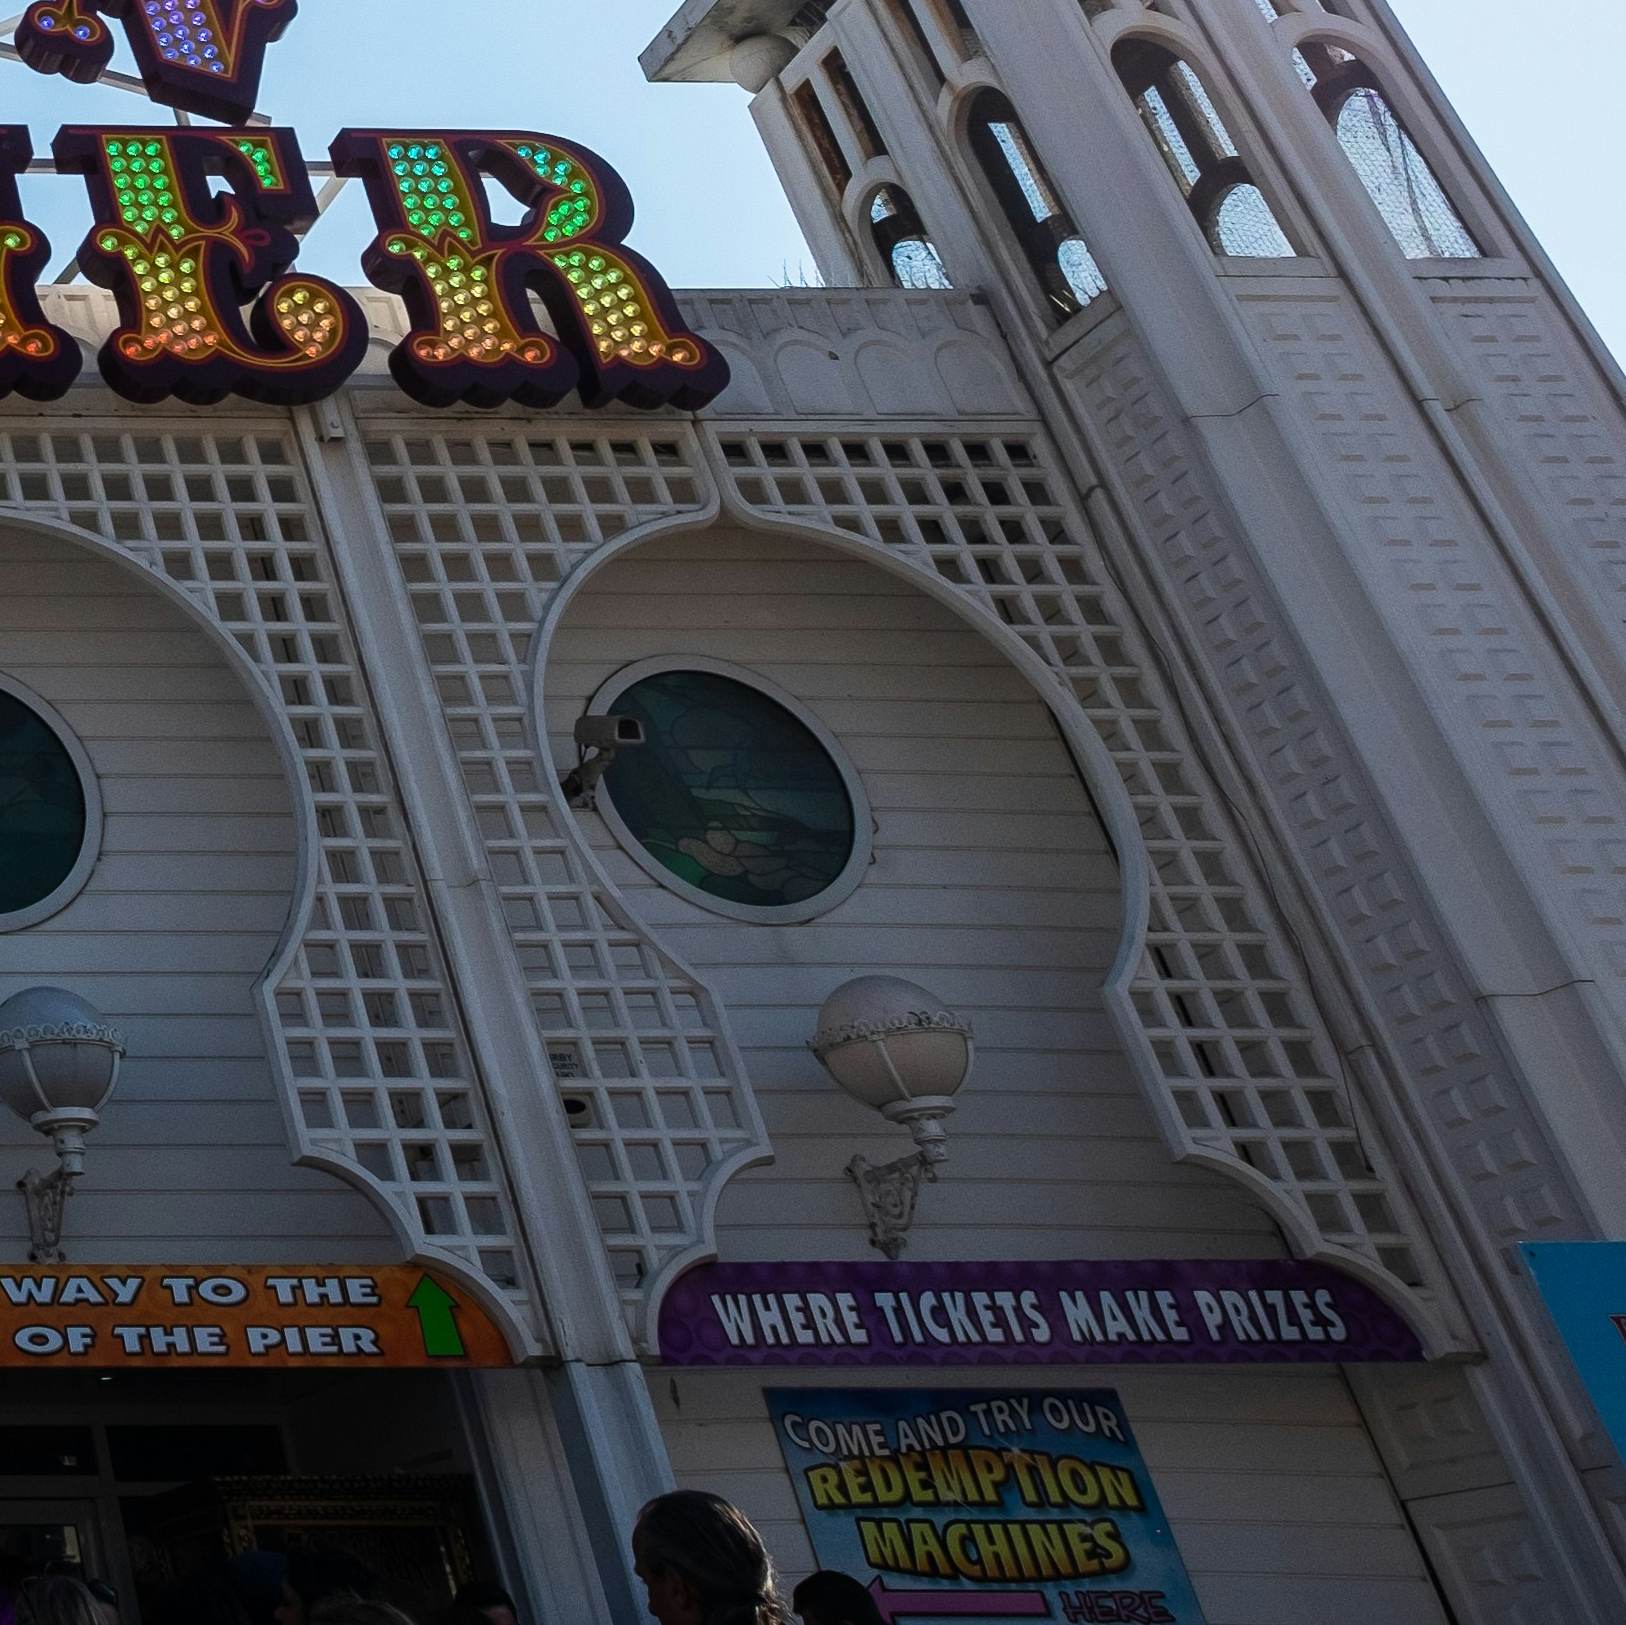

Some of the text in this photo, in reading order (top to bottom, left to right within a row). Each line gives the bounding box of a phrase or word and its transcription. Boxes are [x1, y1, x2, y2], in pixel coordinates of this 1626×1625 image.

[0, 1276, 143, 1305] WAY
[162, 1276, 249, 1306] TO
[266, 1276, 381, 1306] THE
[710, 1289, 1346, 1346] WHERE TICKETS MAKE PRIZES
[13, 1325, 97, 1356] OF
[114, 1326, 231, 1356] THE
[248, 1326, 381, 1356] PIER
[781, 1396, 1126, 1456] COME AND TRY OUR
[804, 1447, 1146, 1512] REDEMPTION
[857, 1519, 1130, 1580] MACHINES
[1059, 1590, 1176, 1624] HERE
